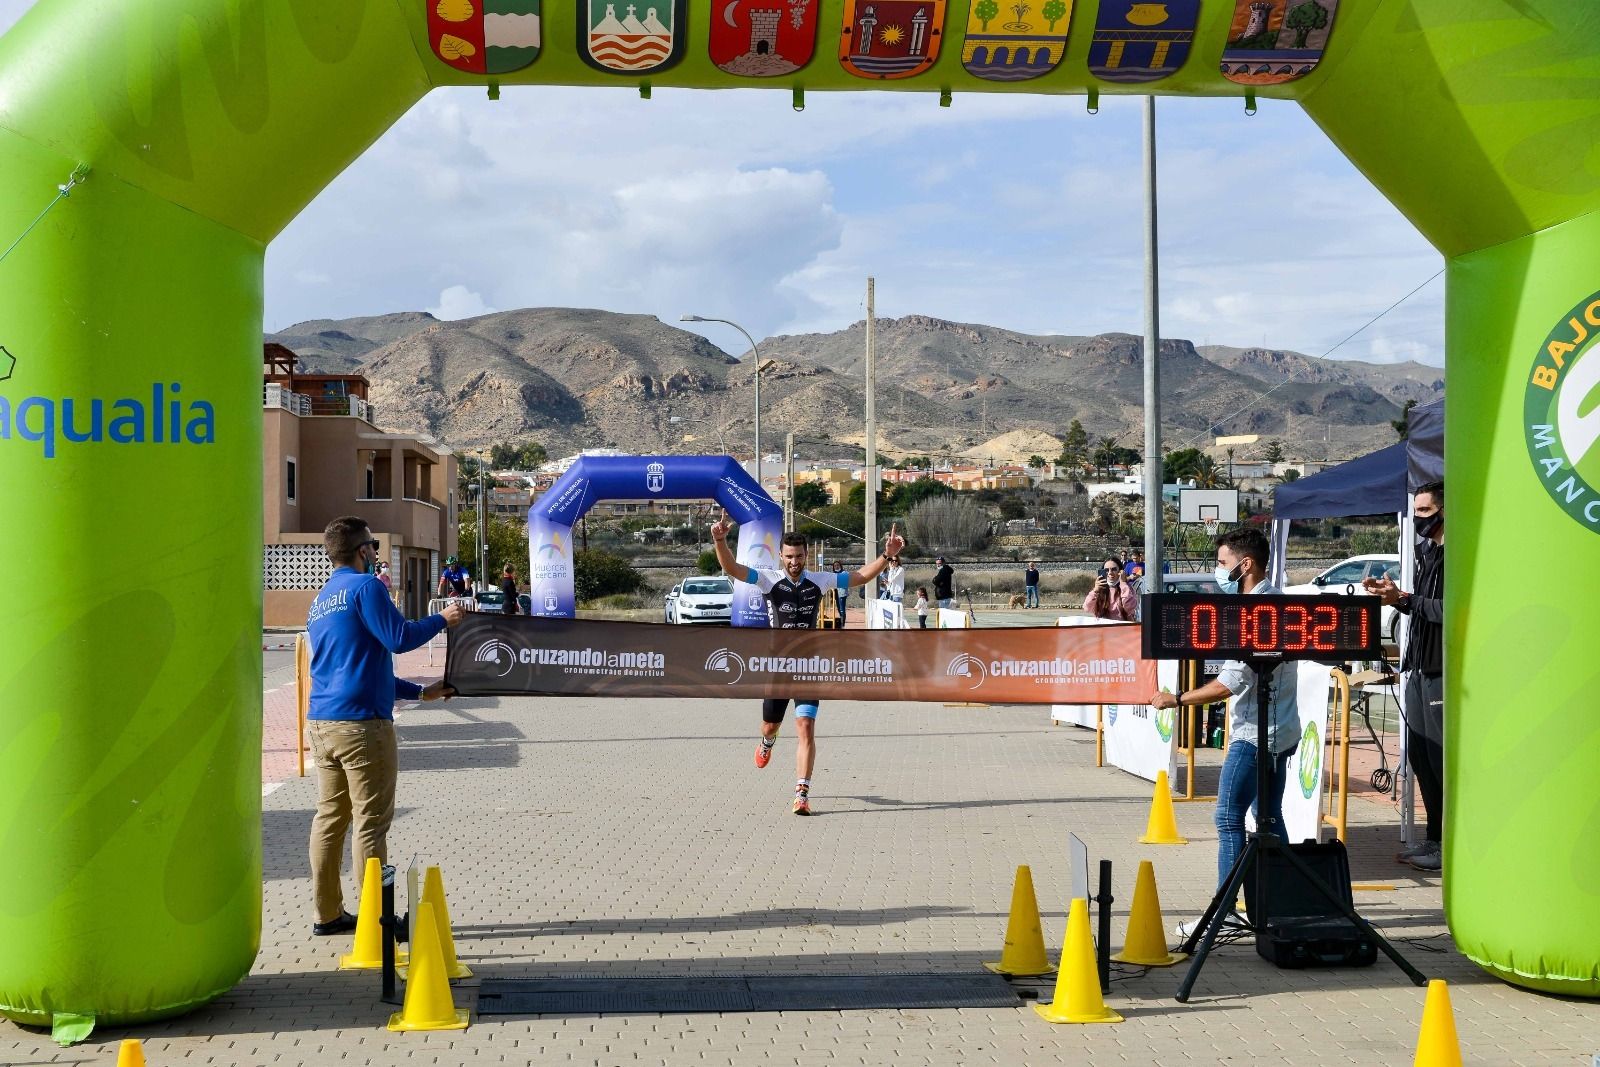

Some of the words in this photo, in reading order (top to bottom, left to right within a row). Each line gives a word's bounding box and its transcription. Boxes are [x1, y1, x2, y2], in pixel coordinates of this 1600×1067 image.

[520, 648, 665, 669] cruzandolameta
[748, 655, 892, 675] cruzandolameta
[623, 668, 665, 677] deportivo
[991, 657, 1136, 677] cruzandolameta
[851, 675, 893, 683] deportivo
[1094, 675, 1136, 683] deportivo
